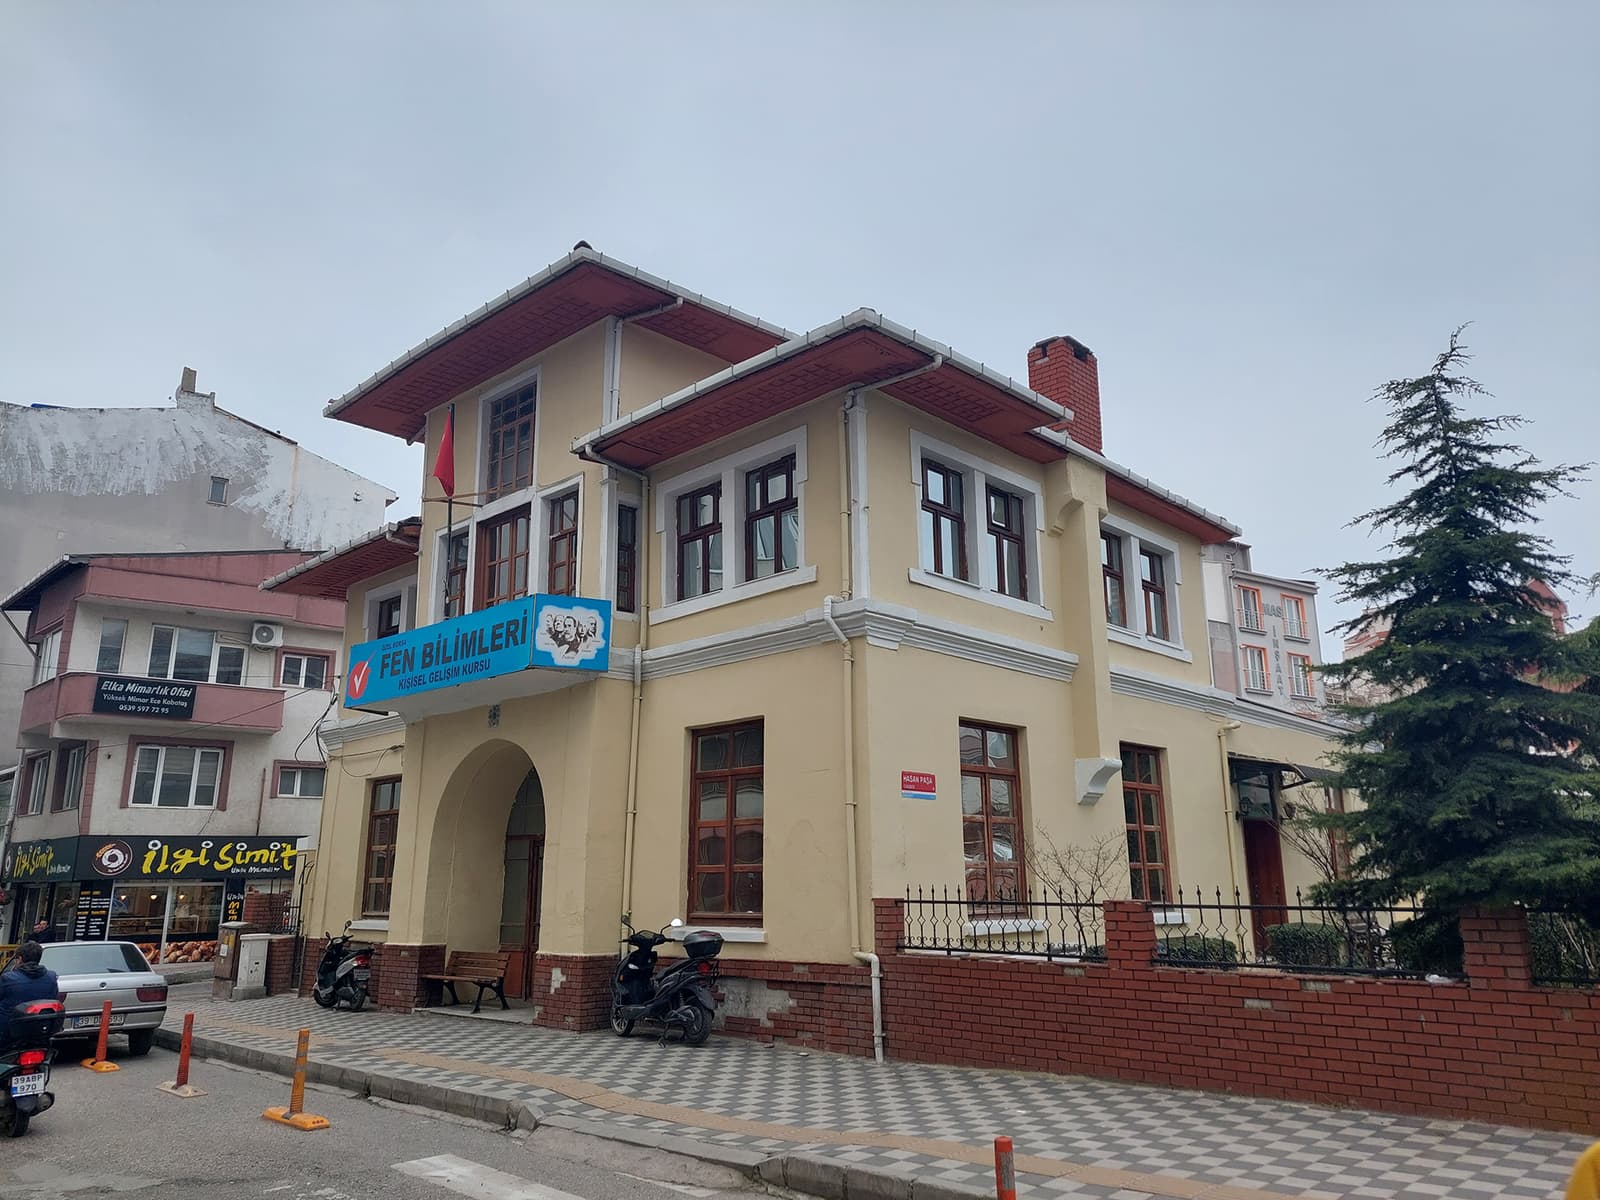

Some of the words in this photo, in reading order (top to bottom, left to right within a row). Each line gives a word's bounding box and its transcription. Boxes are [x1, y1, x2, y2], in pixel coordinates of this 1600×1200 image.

[380, 646, 416, 679] FEN
[421, 609, 528, 669] BİLİMLERİ
[398, 673, 427, 692] KİŞİSEL
[429, 664, 460, 684] GELİŞİM
[462, 659, 491, 678] KURSU
[101, 680, 124, 691] Elka
[125, 682, 169, 696] Mimarlık
[170, 686, 192, 697] Ofisi
[213, 842, 297, 871] Simit
[79, 1016, 90, 1025] 39
[20, 1083, 37, 1092] 970
